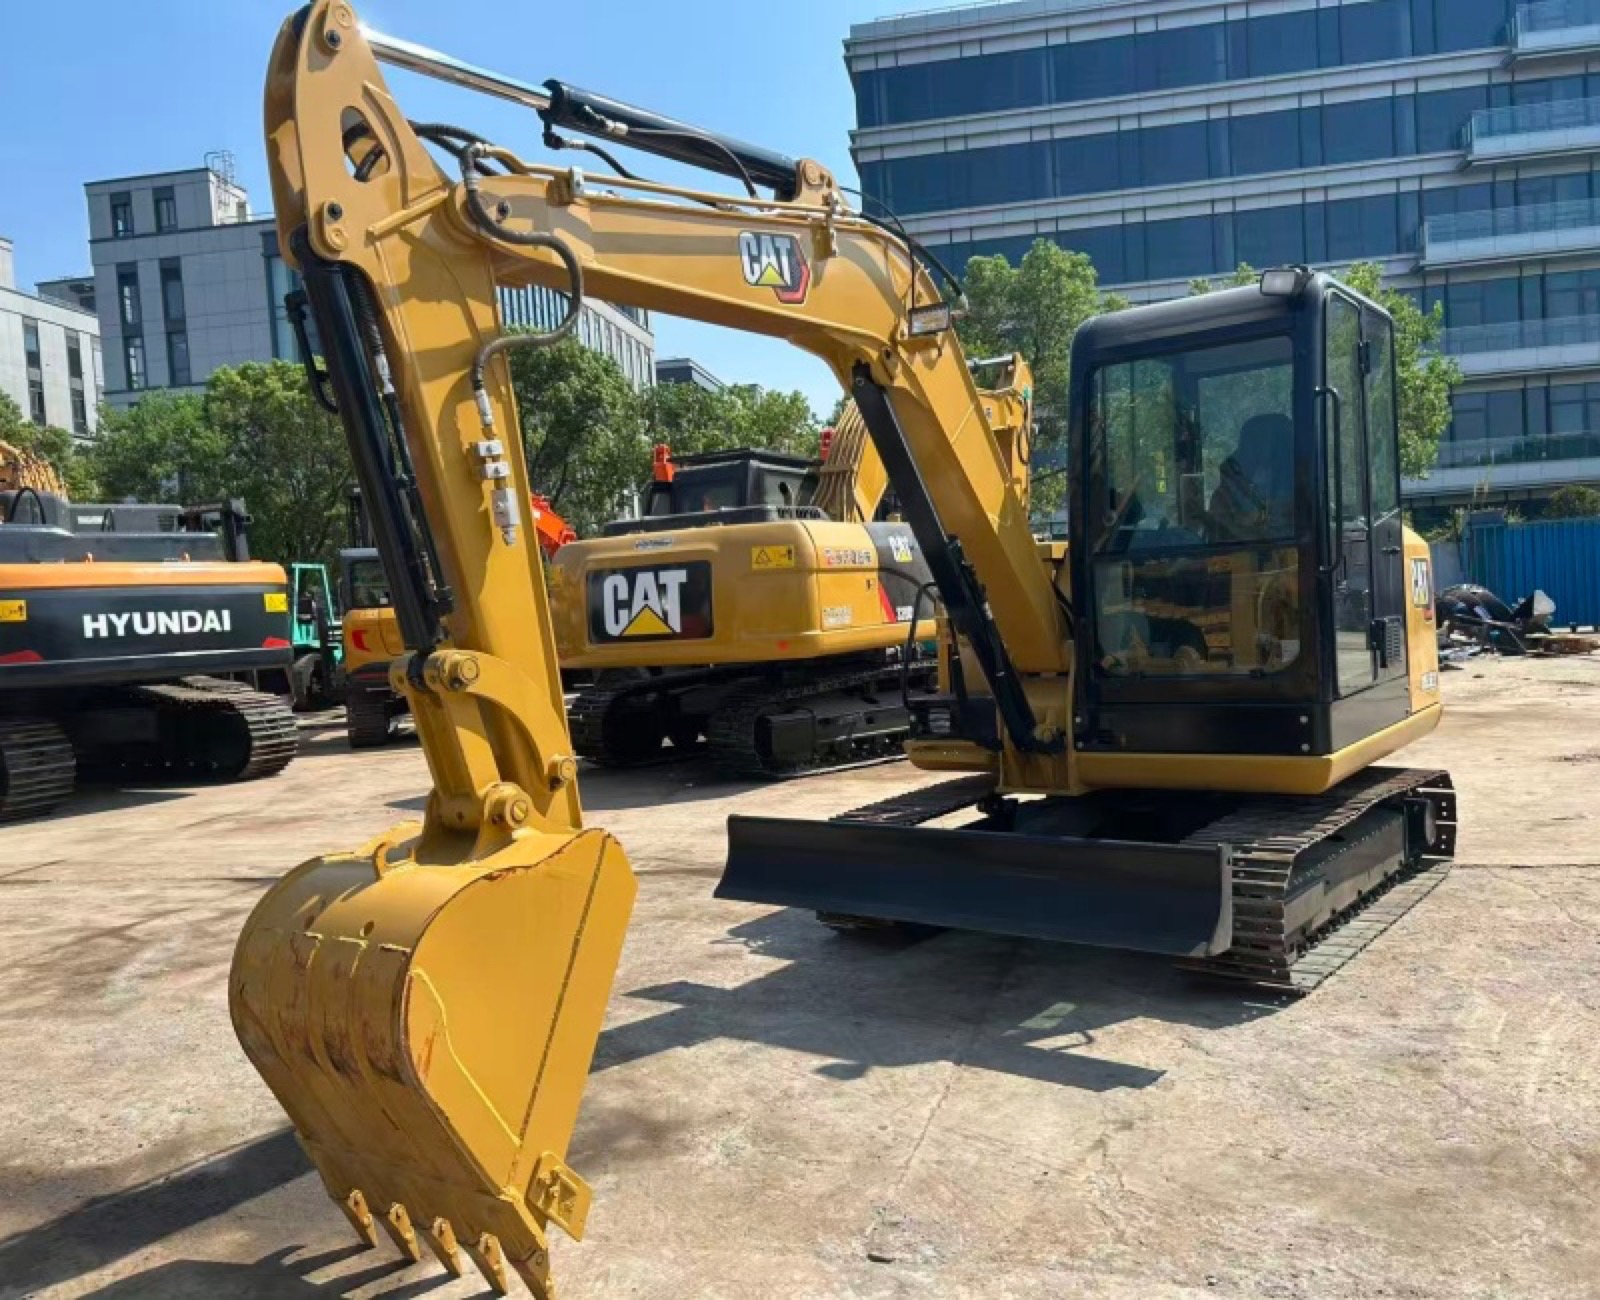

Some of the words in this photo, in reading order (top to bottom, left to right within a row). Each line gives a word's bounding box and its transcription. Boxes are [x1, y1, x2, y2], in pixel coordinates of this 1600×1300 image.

[739, 231, 791, 286] CAT
[83, 609, 231, 638] HYUNDAI
[604, 569, 687, 636] CAT
